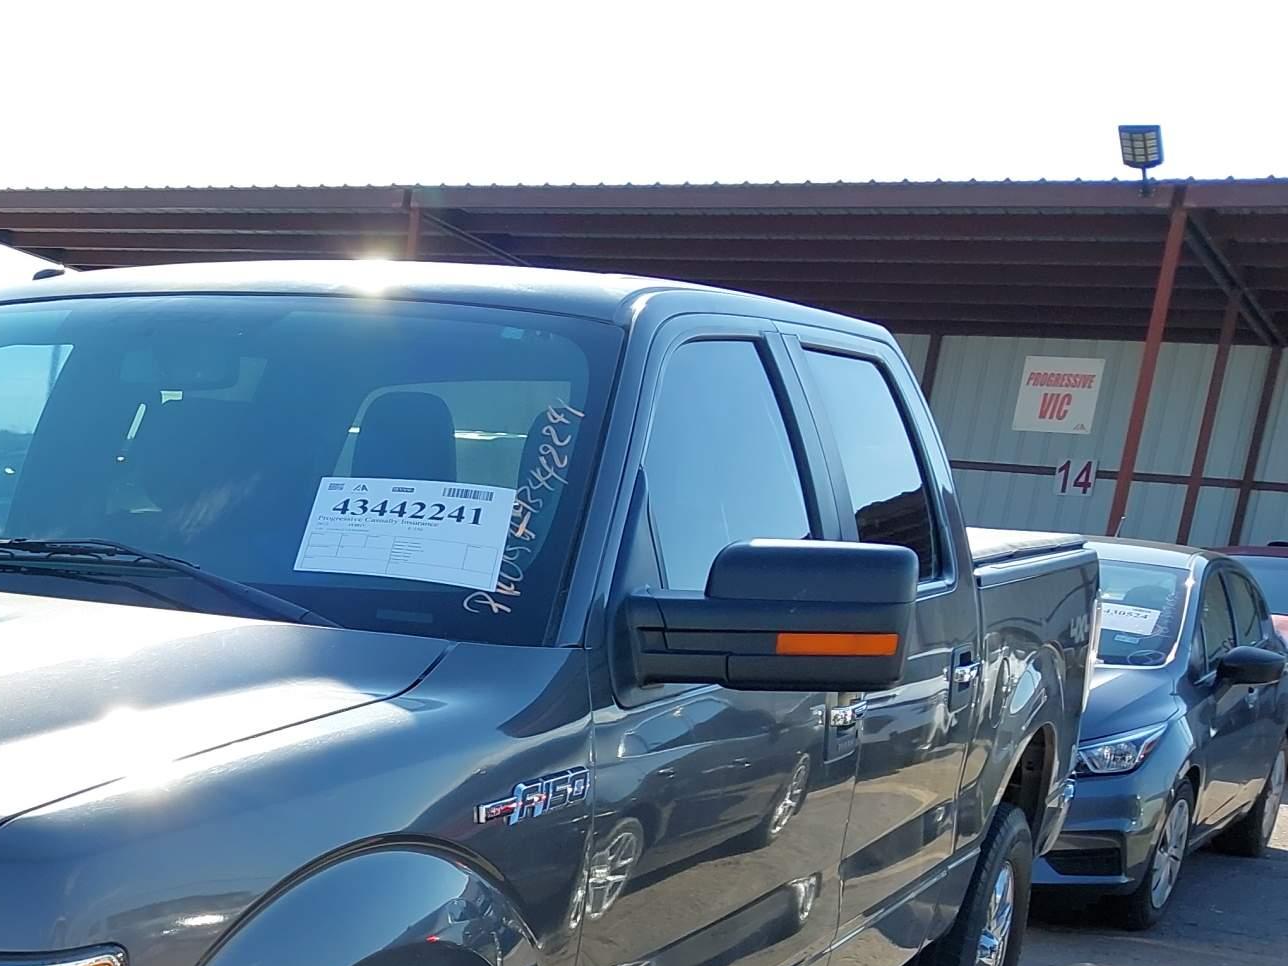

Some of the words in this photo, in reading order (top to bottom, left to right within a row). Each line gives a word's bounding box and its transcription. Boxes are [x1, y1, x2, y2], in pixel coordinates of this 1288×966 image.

[1026, 372, 1096, 389] PROGRESSIVE
[1038, 392, 1073, 421] VIC
[1058, 459, 1092, 494] 14
[318, 515, 362, 523] Progressive
[365, 516, 398, 525] Casualty
[400, 519, 439, 528] Insurance
[332, 498, 482, 525] 43442241
